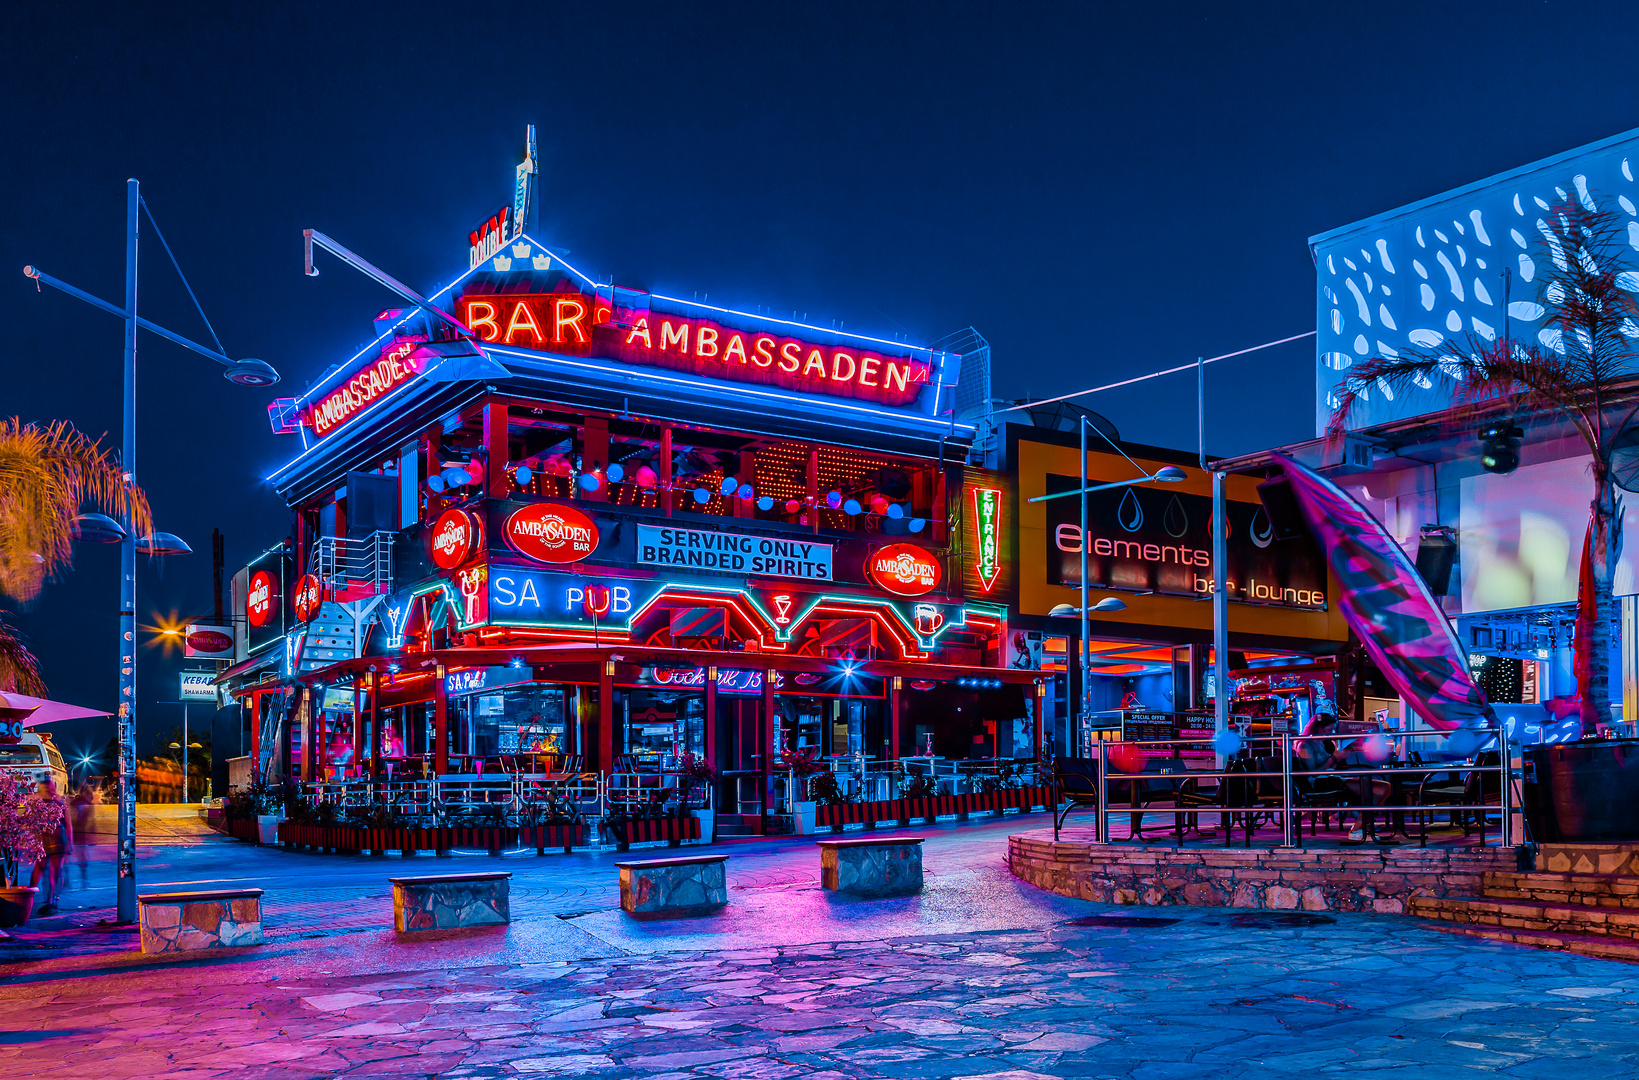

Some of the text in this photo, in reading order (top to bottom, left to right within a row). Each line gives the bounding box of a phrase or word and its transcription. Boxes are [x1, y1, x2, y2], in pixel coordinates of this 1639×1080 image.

[470, 220, 509, 270] DOUBLE
[462, 301, 591, 343] BAR
[625, 317, 909, 392] AMBASSADEN
[574, 542, 590, 552] BAR
[660, 529, 813, 559] SERVING ONLY
[983, 490, 994, 578] ENTRANCE
[643, 546, 828, 578] BRANDED SPIRITS
[494, 577, 632, 613] SA PUB
[921, 577, 934, 586] BAR
[1250, 579, 1325, 606] lounge
